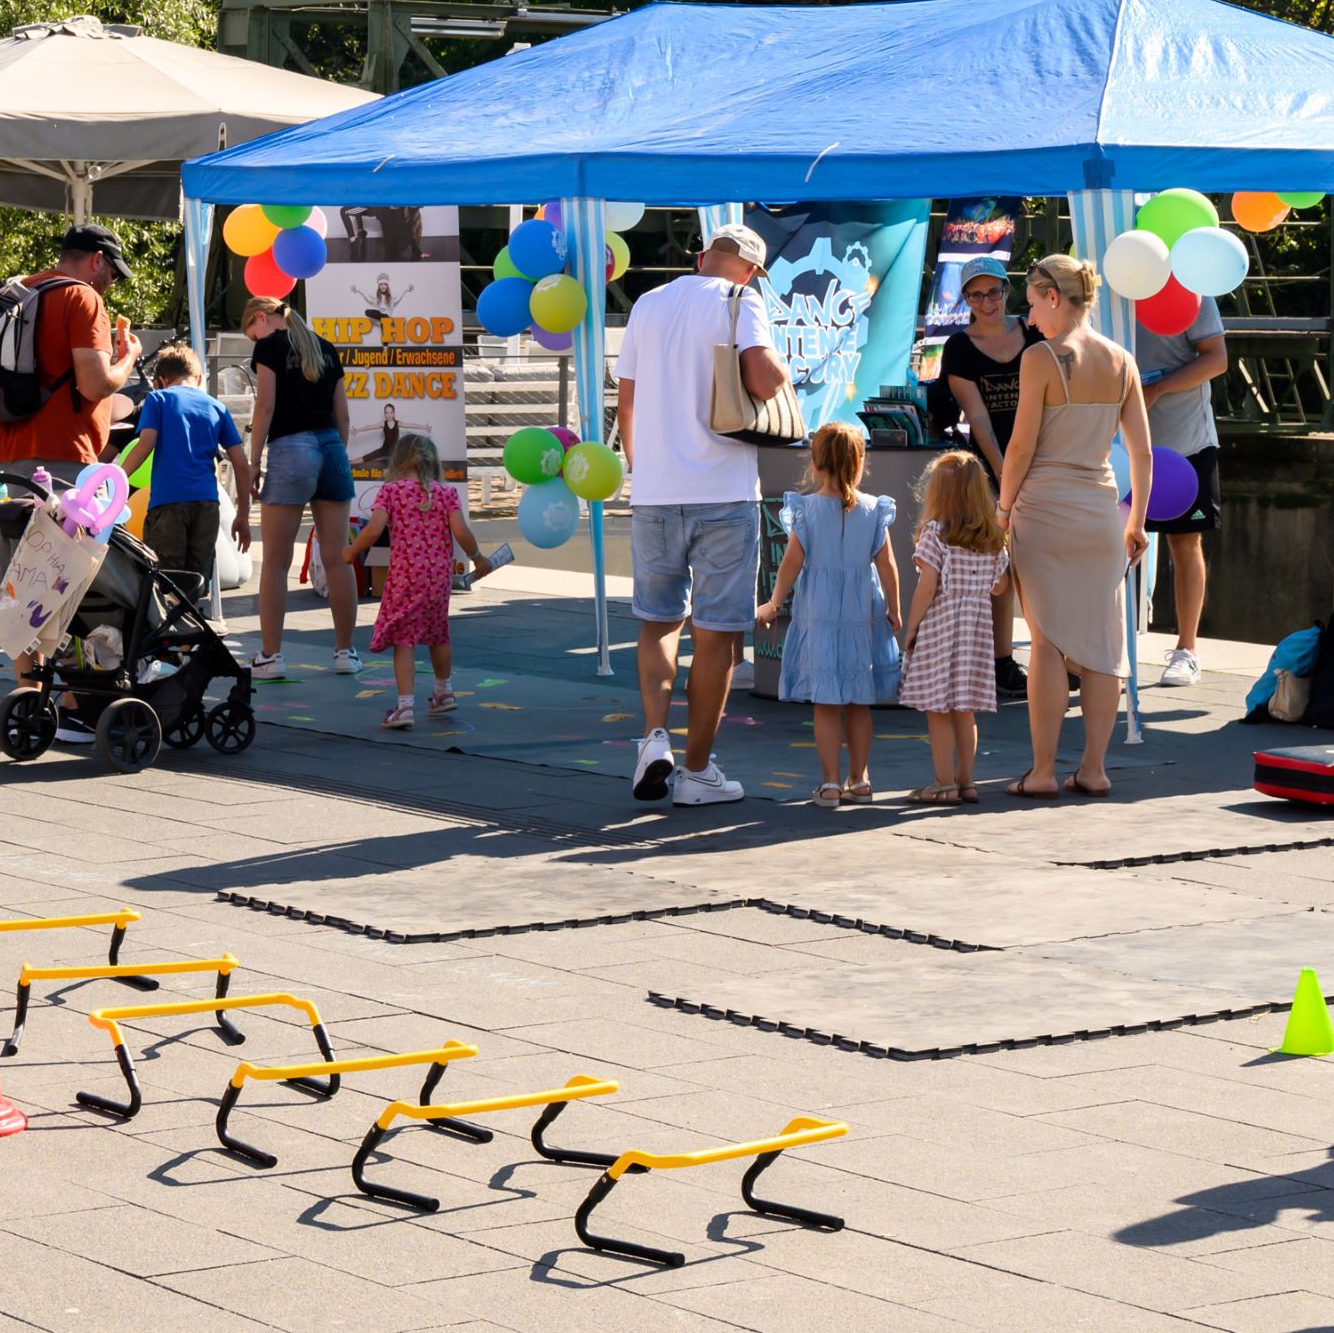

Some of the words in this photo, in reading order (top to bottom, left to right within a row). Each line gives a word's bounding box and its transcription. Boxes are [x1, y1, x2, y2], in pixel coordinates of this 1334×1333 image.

[312, 317, 373, 343] HIP
[381, 317, 454, 343] HOP
[352, 348, 389, 368] Jugend
[396, 349, 455, 365] Erwachsene
[374, 372, 458, 399] DANCE
[983, 377, 1019, 392] DANC
